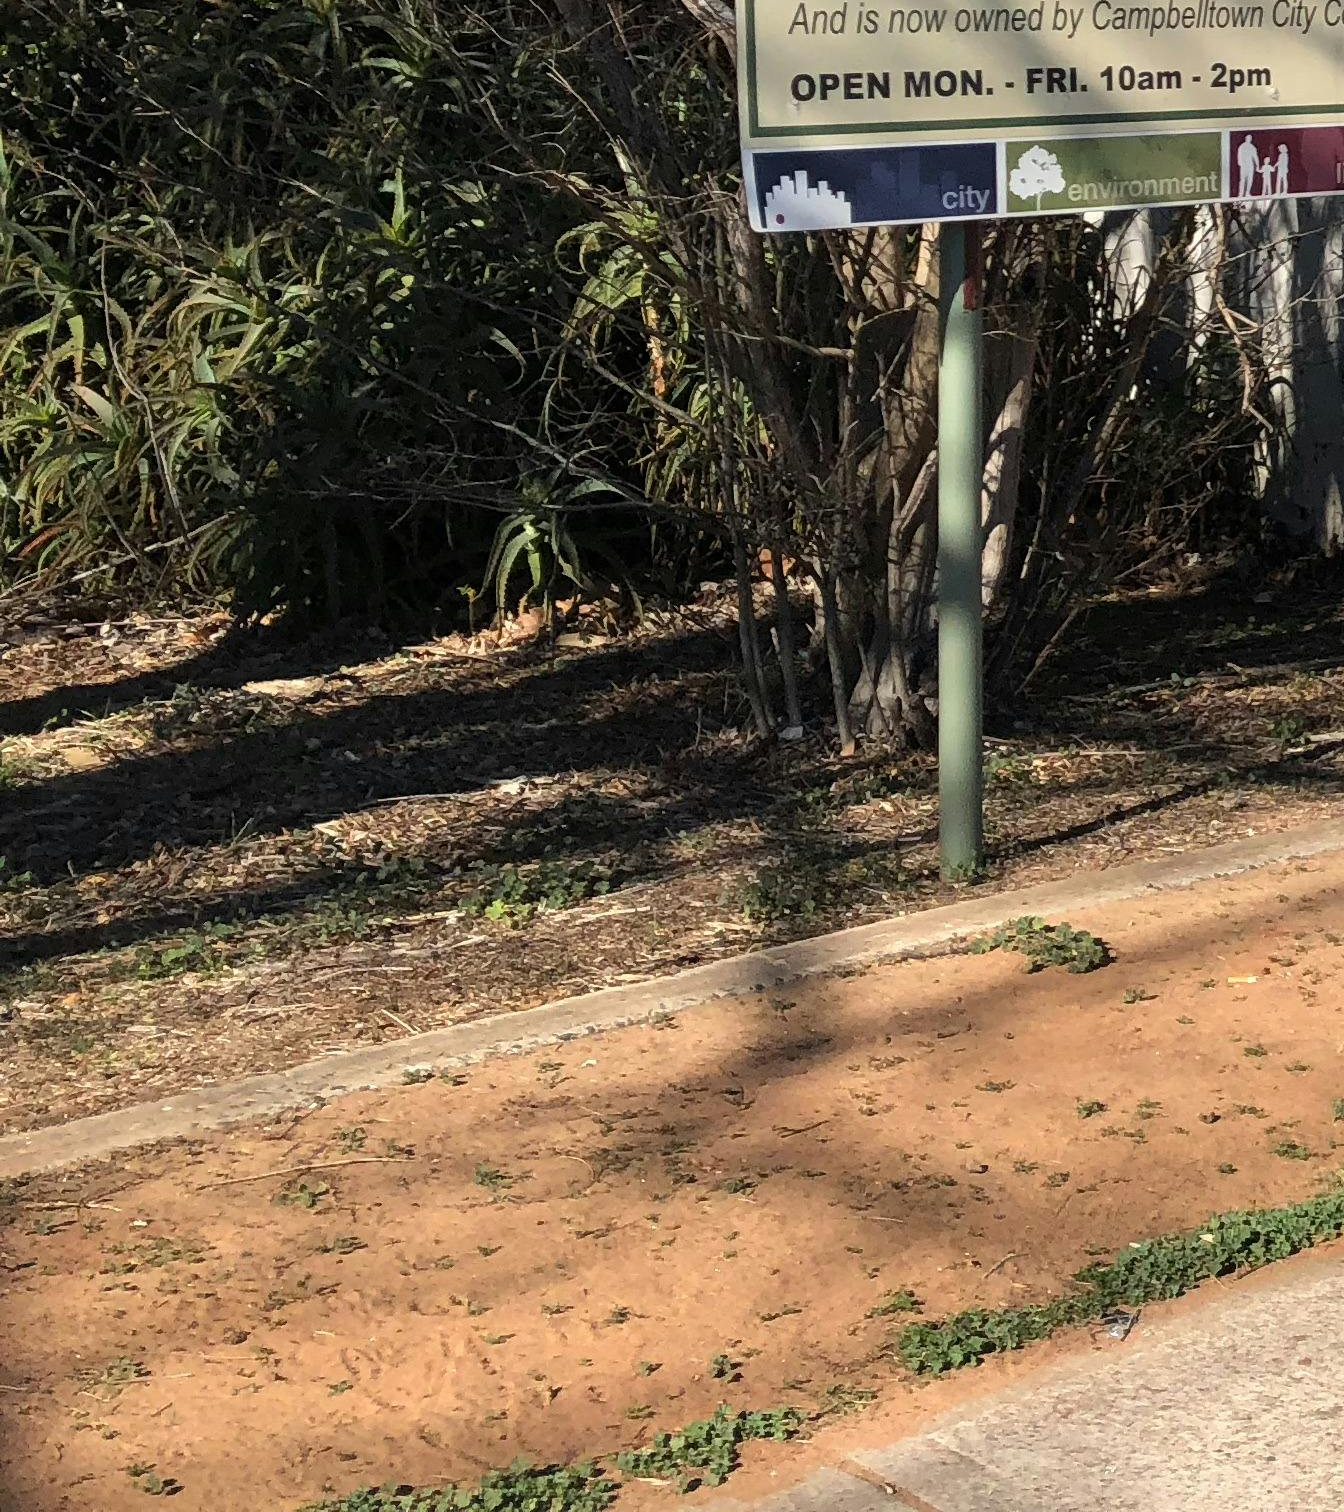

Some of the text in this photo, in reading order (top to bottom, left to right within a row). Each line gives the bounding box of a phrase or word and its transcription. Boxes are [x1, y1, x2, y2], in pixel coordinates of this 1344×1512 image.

[788, 2, 847, 36] And
[856, 1, 879, 34] is
[888, 8, 947, 34] now
[954, 1, 1045, 33] owned
[1052, 1, 1084, 38] by
[1092, 0, 1265, 37] Campbelltown
[1272, 0, 1318, 35] City
[791, 71, 891, 102] OPEN
[904, 69, 994, 99] MON.
[1025, 67, 1089, 94] FRI.
[1099, 65, 1183, 92] 10am
[1210, 62, 1272, 94] 2pm
[941, 187, 991, 212] city
[1067, 172, 1219, 202] environment
